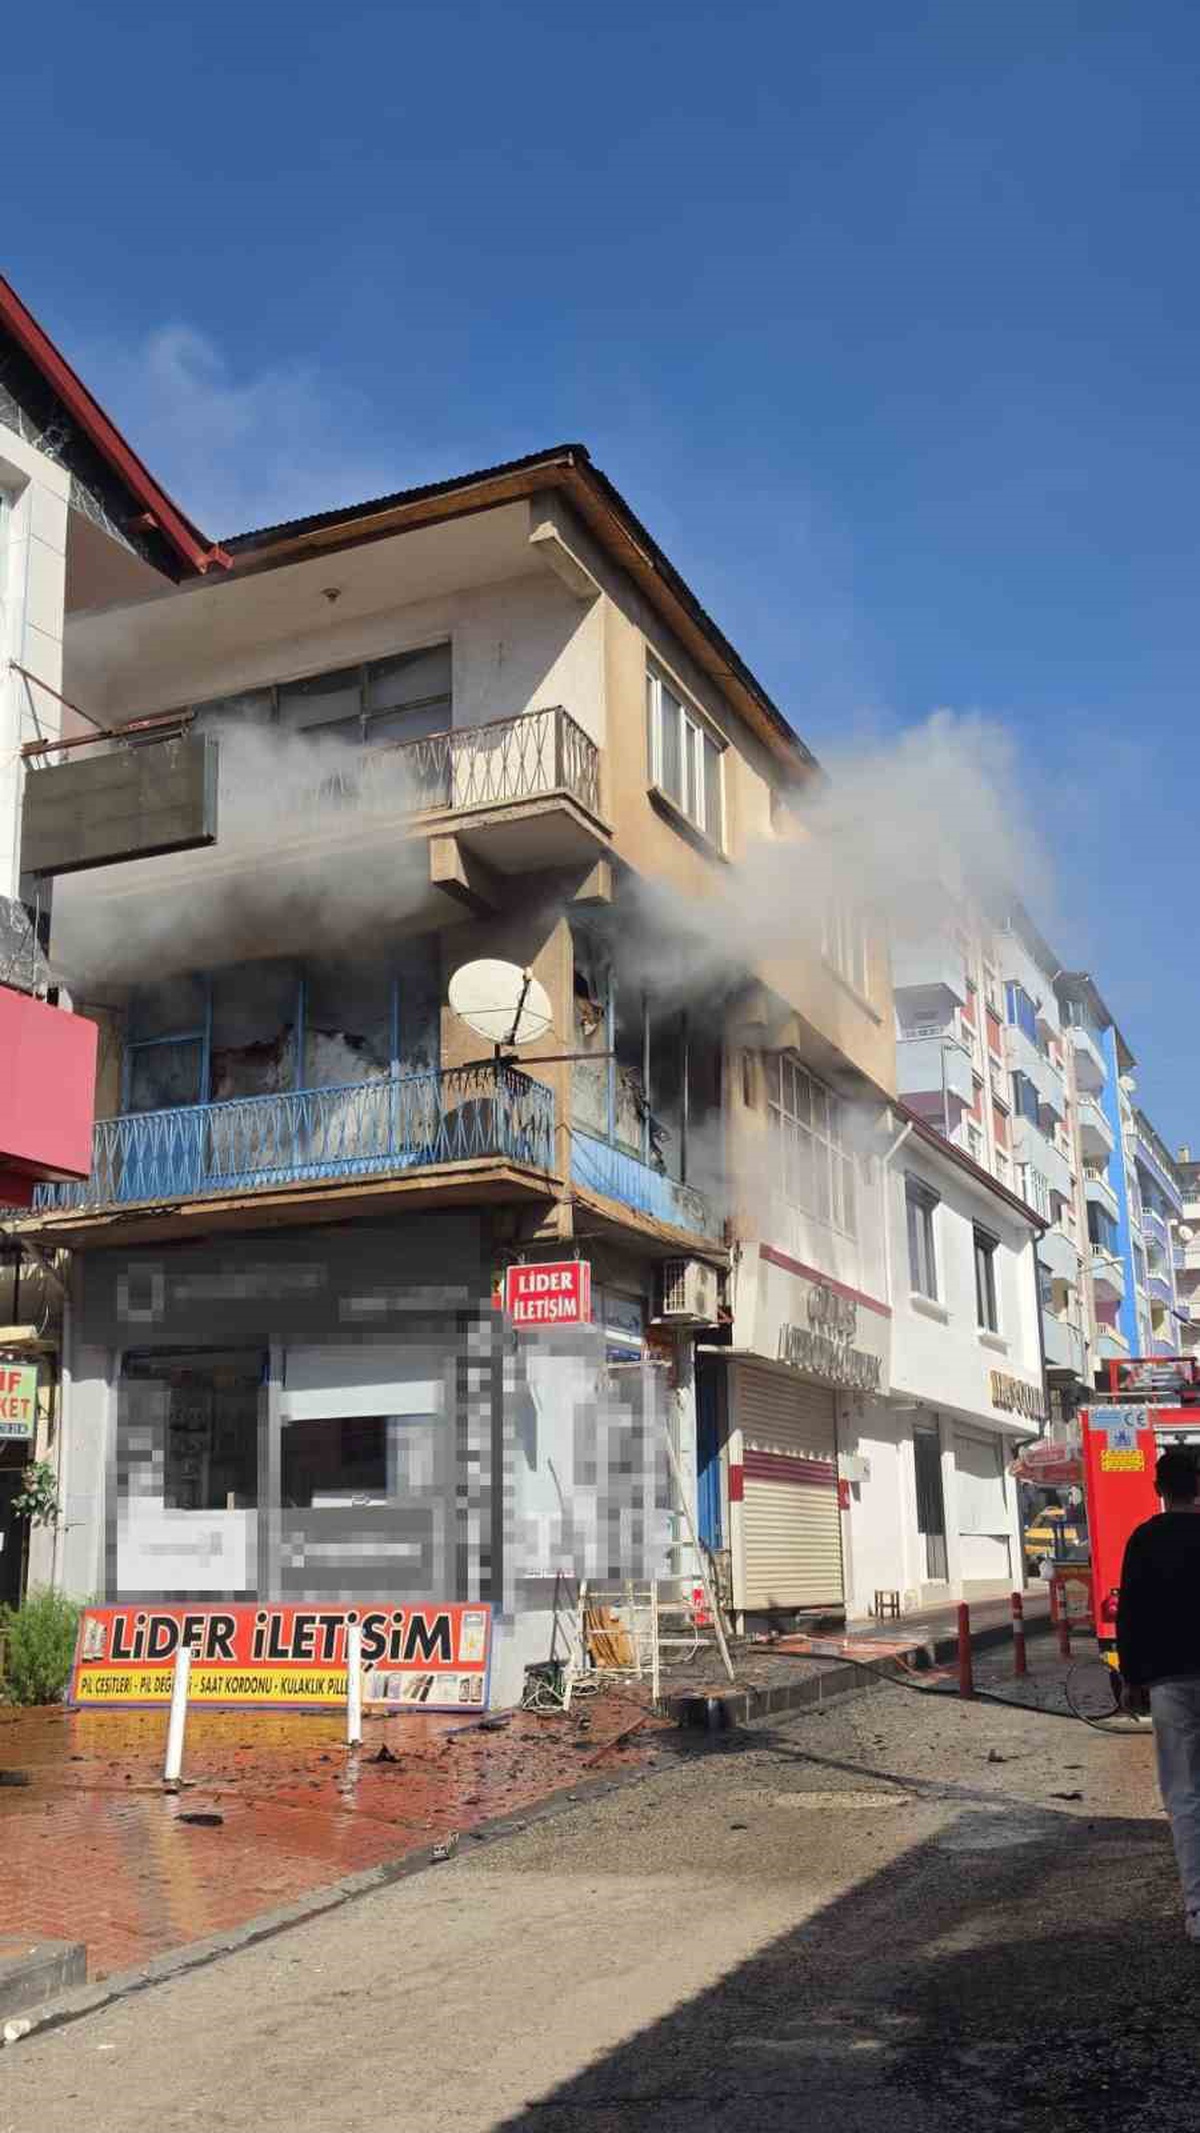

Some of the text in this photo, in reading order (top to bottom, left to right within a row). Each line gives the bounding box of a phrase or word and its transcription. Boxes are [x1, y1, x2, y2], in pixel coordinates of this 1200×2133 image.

[518, 1271, 573, 1293] LİDER
[514, 1296, 576, 1322] İLETİŞİM
[200, 1676, 222, 1694] SAAT
[223, 1676, 272, 1694] KORDONU
